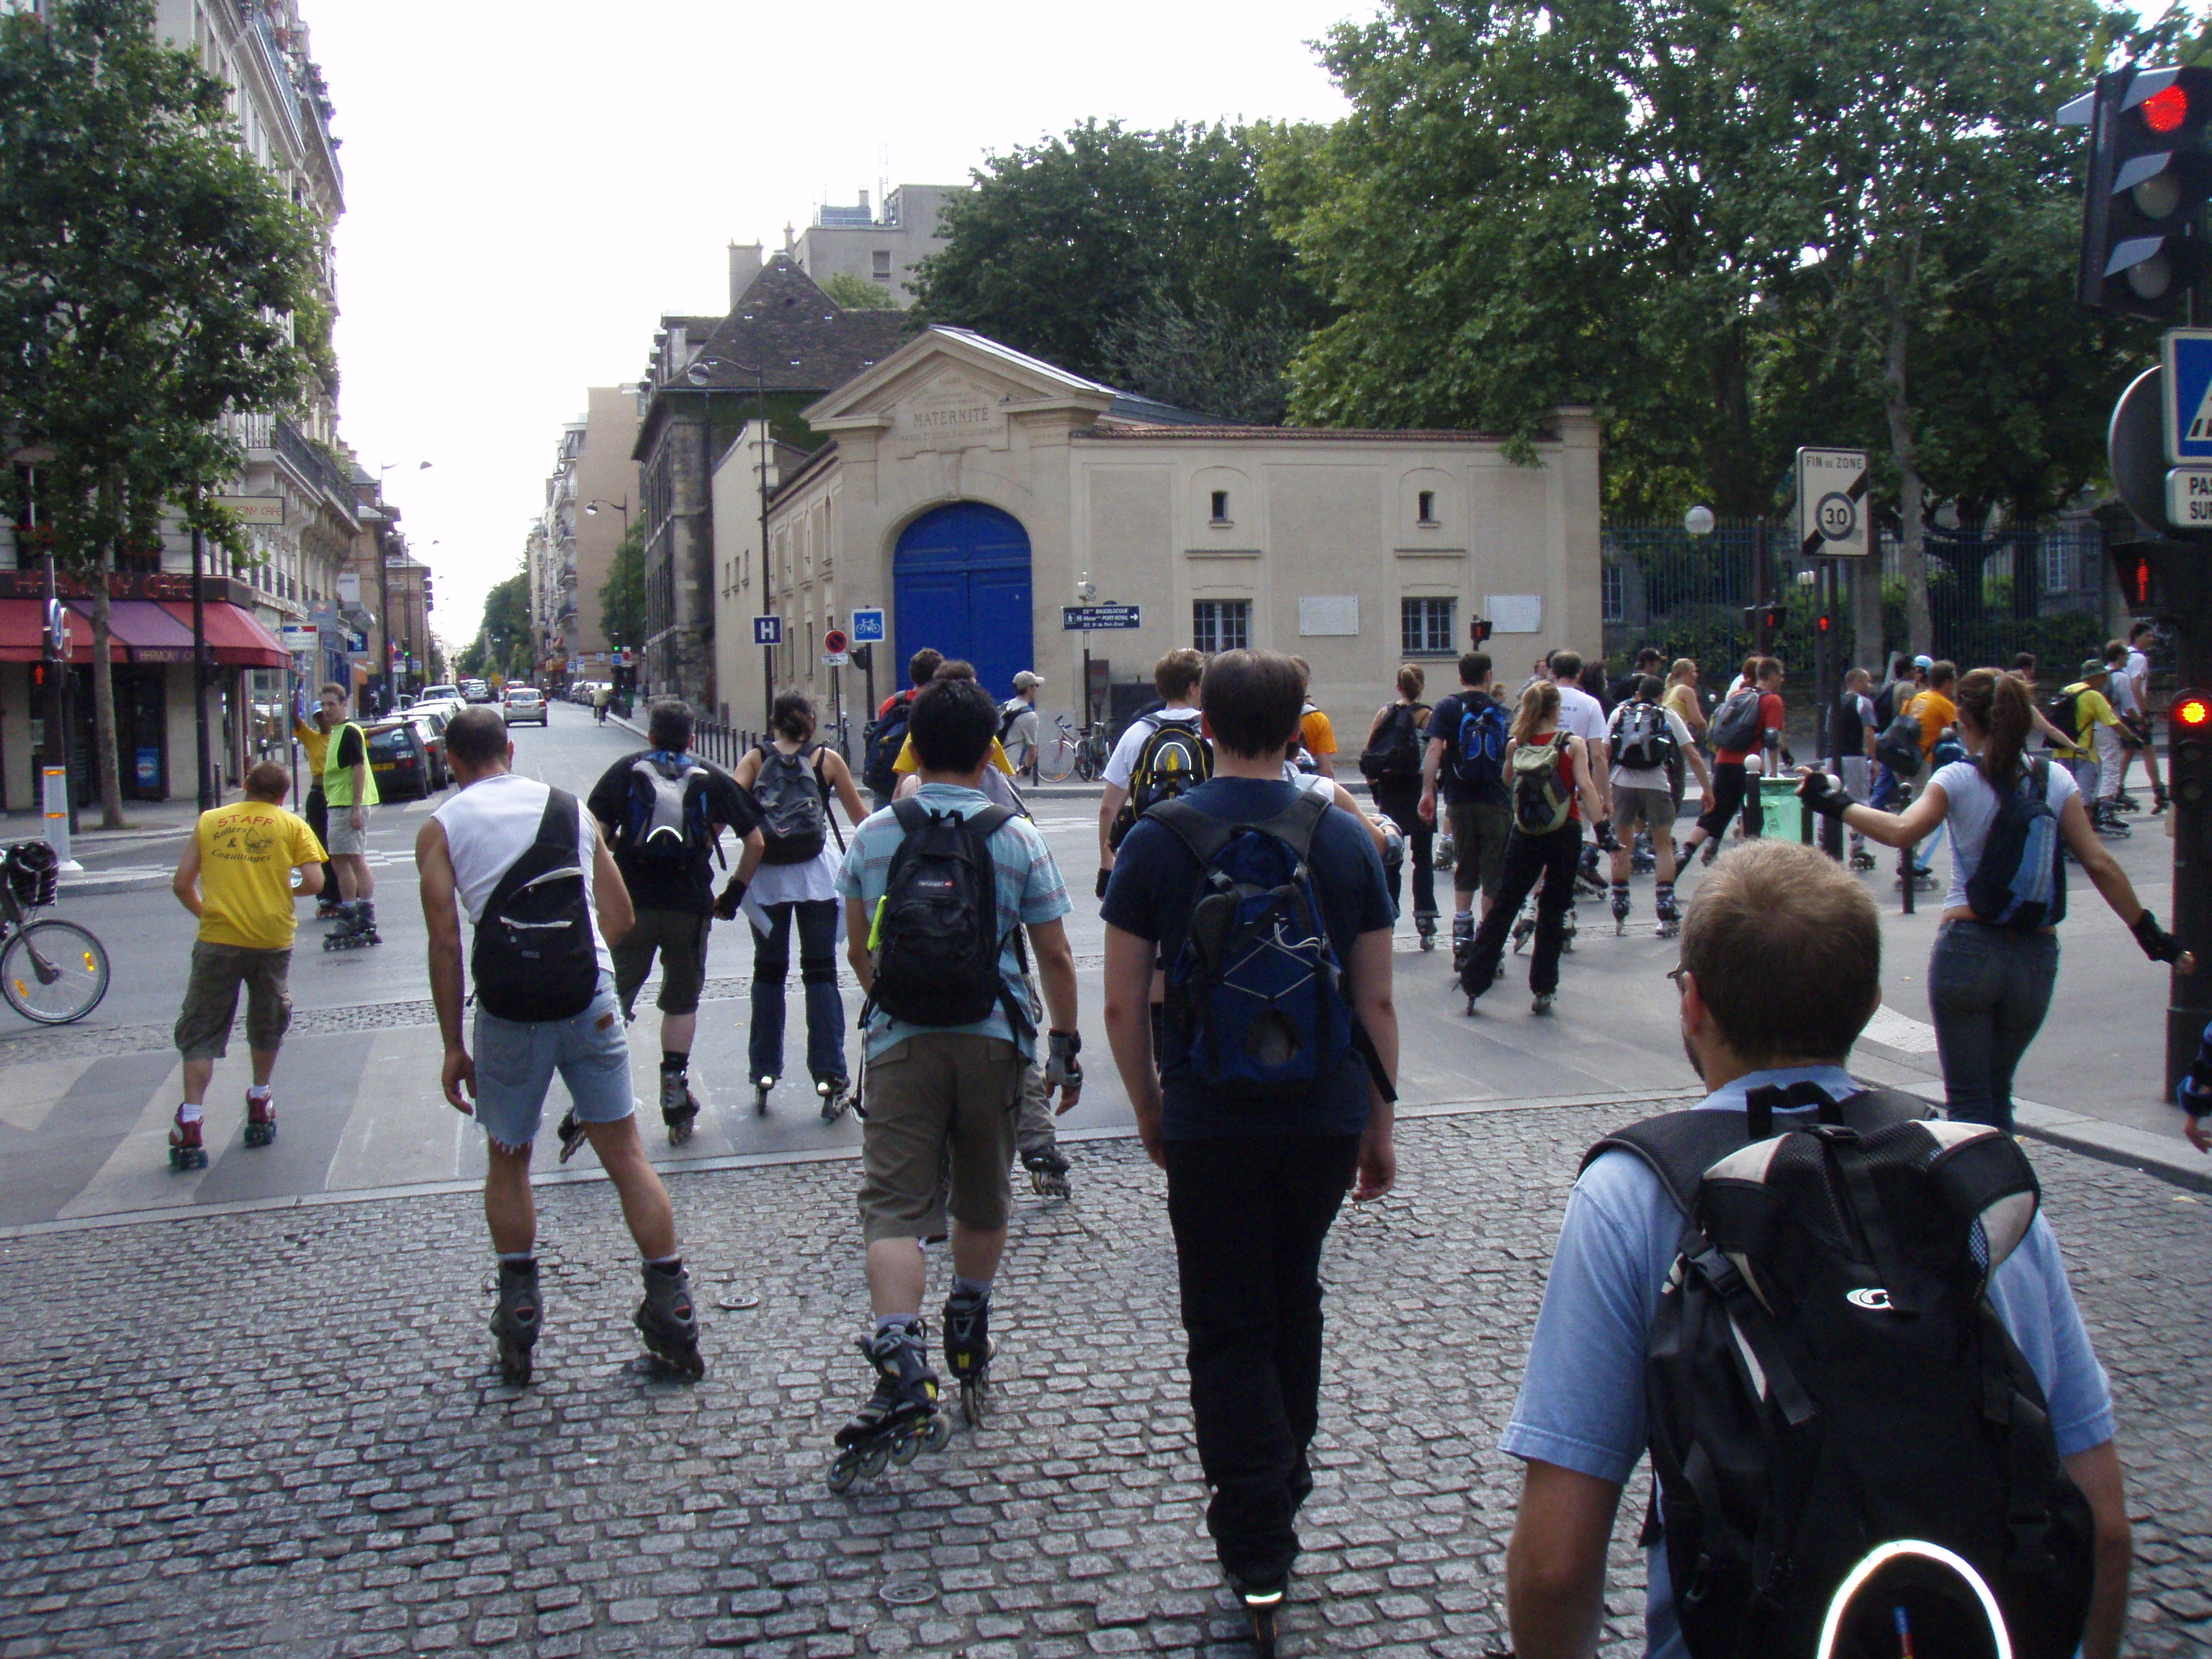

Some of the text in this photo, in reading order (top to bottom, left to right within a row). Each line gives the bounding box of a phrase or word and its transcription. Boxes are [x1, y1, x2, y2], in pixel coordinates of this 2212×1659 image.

[914, 404, 989, 428] MATERNITÉ
[1806, 455, 1822, 467] FIN
[1835, 457, 1863, 469] ZONE
[2190, 477, 2212, 495] PA
[261, 507, 282, 516] CAFE
[1825, 508, 1848, 525] 30
[760, 621, 774, 640] H
[218, 814, 275, 827] STAFF
[213, 827, 246, 840] Rollers
[227, 837, 237, 848] &
[212, 849, 272, 863] Coquillages
